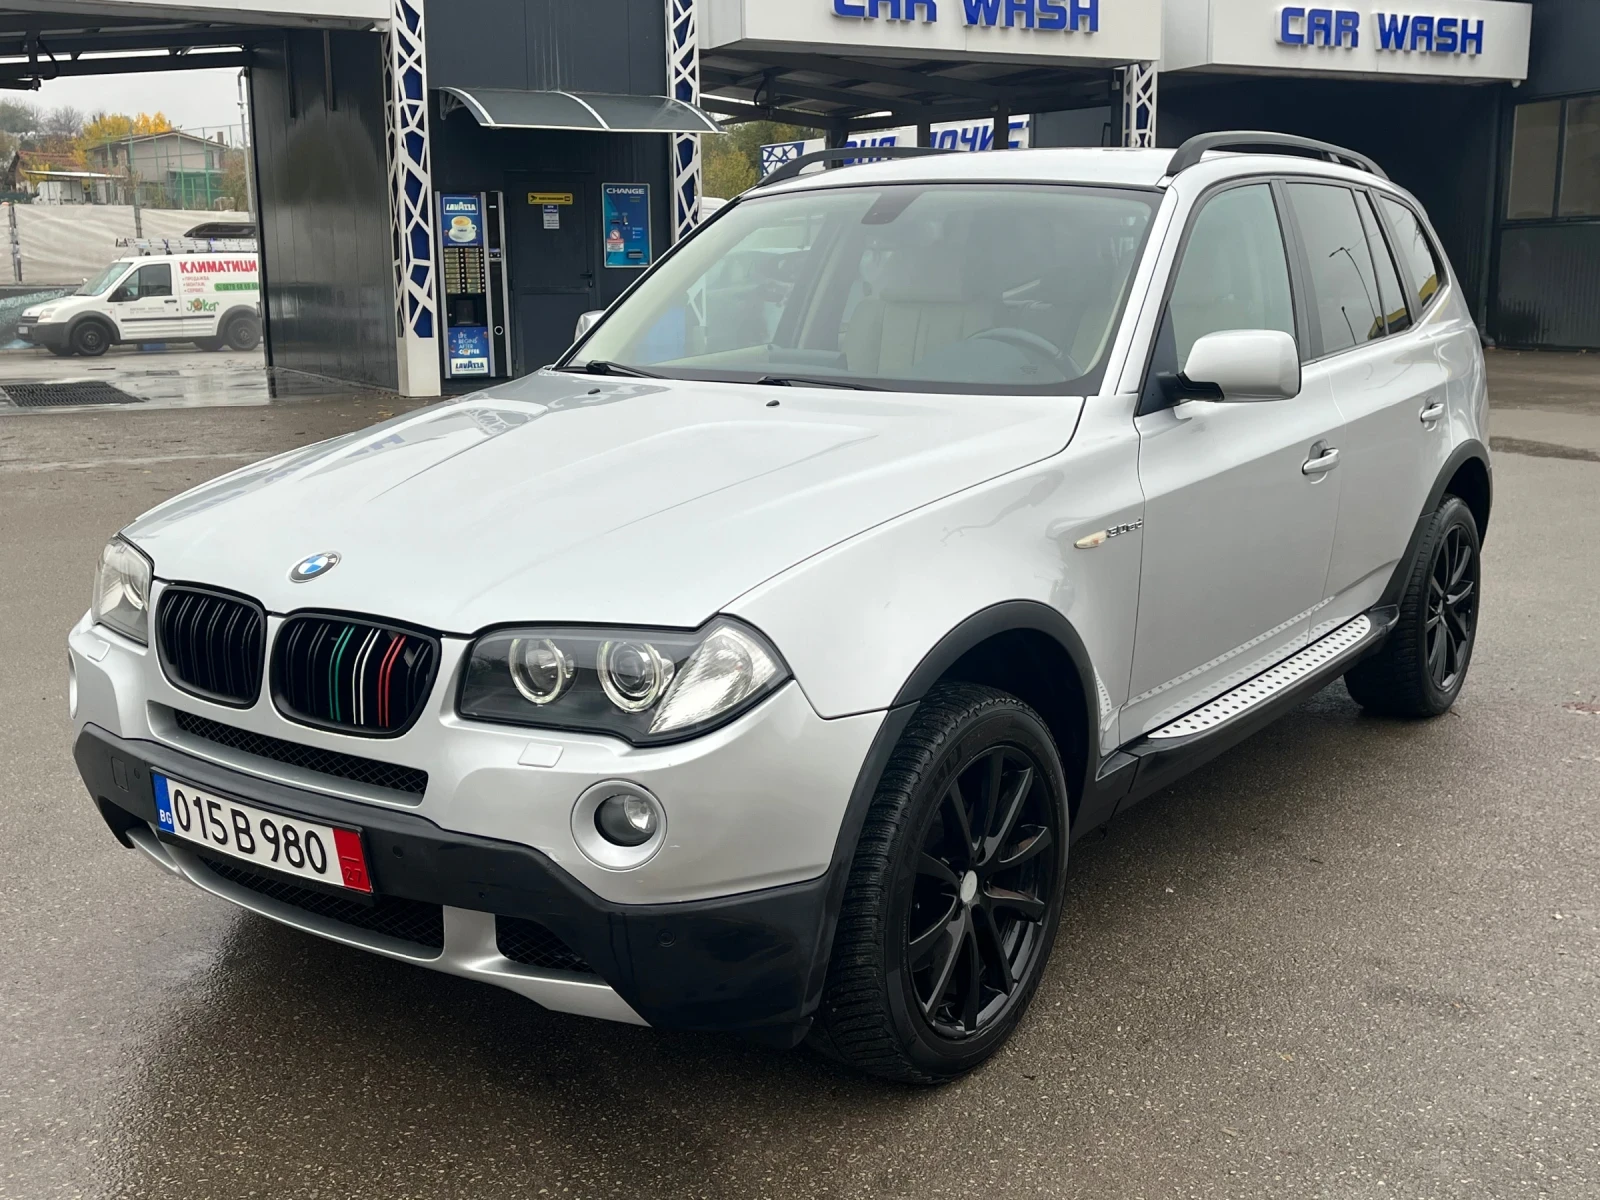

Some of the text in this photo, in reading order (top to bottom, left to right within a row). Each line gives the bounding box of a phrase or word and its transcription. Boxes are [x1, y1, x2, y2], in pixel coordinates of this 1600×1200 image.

[962, 0, 1099, 32] WASH
[1280, 7, 1484, 54] CAR WASH
[606, 187, 645, 195] CHANGE
[445, 201, 477, 211] LAVAZZA
[179, 260, 257, 273] КЛИМАТИЦИ
[455, 360, 485, 370] LAVAZZA
[160, 809, 172, 825] BG
